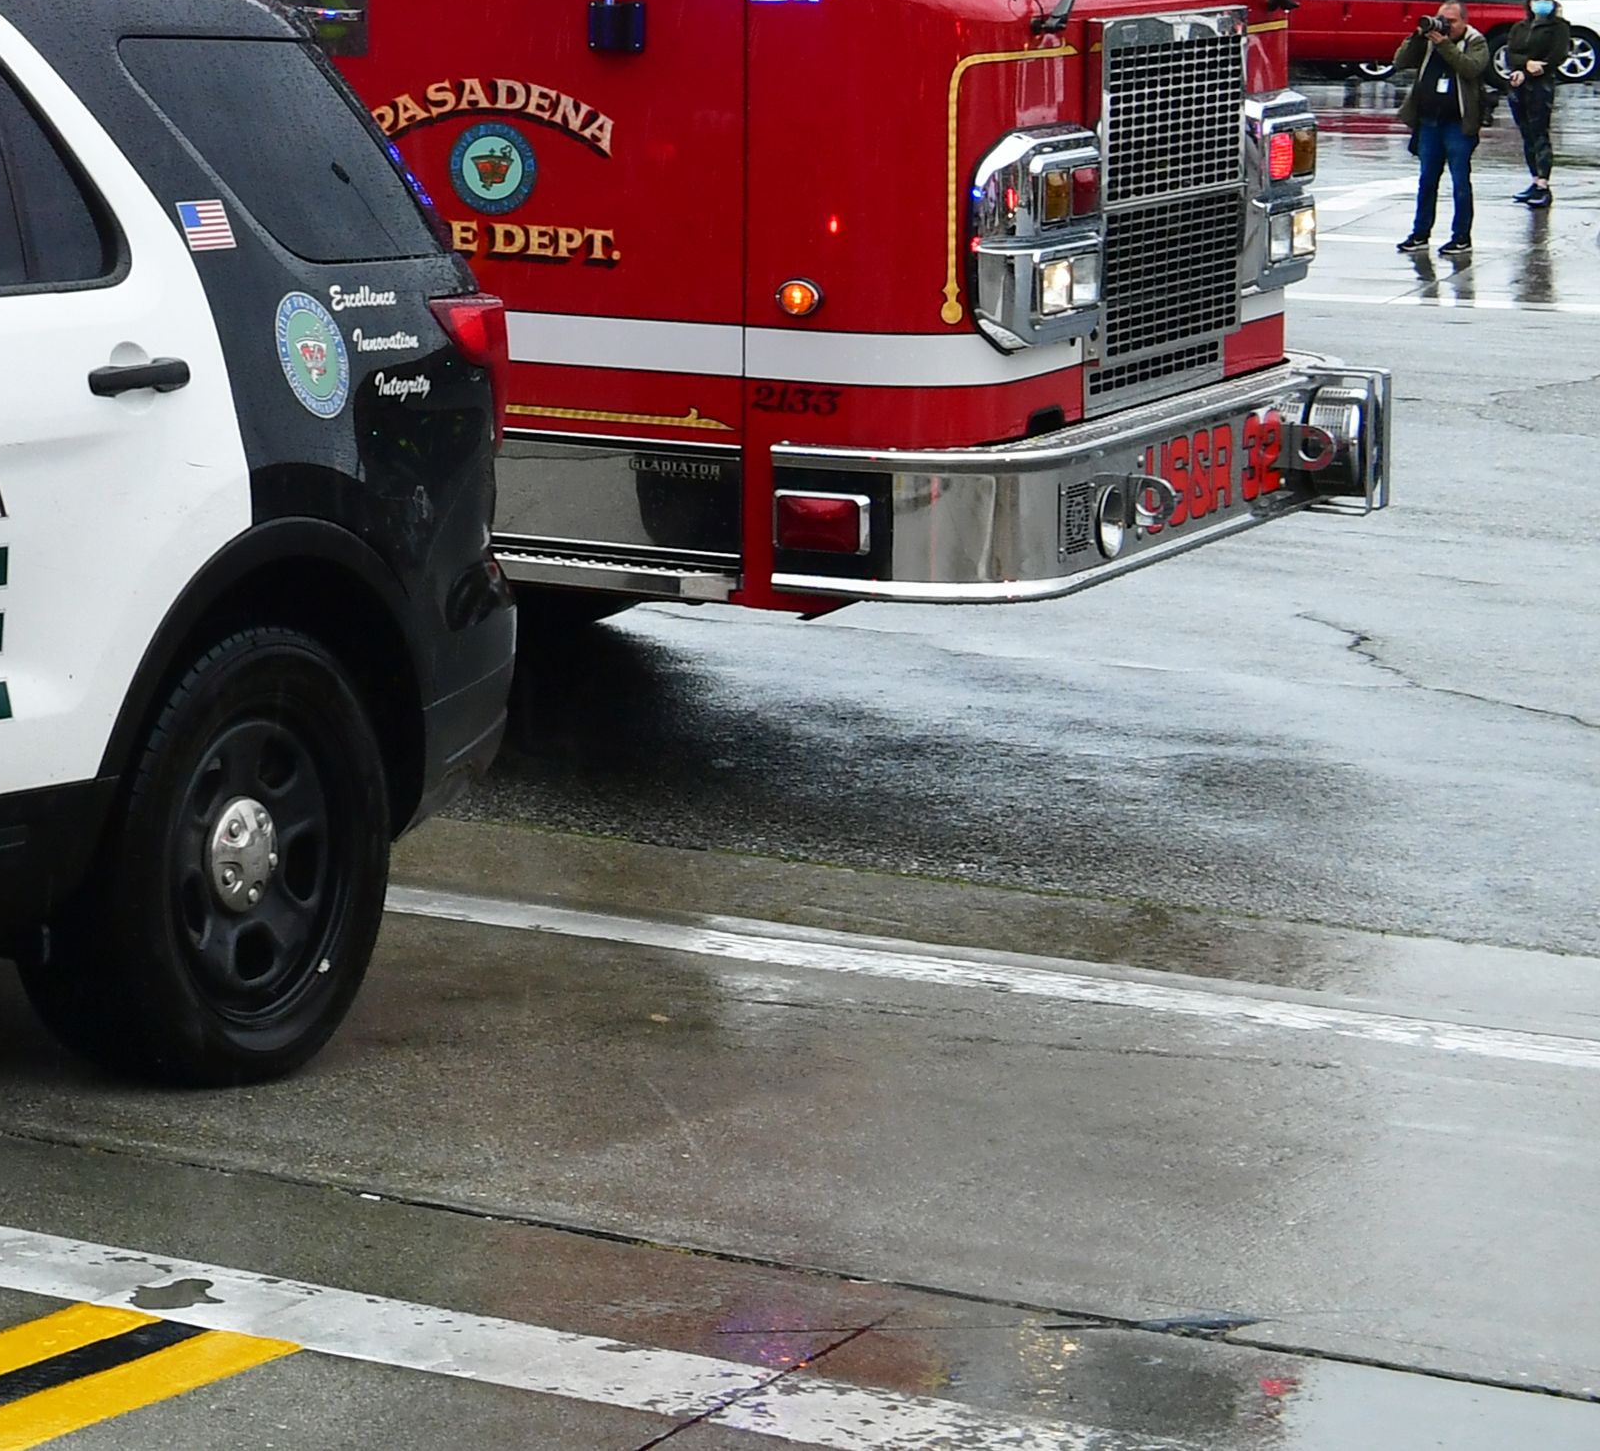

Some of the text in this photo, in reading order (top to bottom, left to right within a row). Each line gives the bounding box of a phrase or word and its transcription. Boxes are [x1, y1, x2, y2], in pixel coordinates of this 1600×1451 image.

[490, 223, 621, 261] DEPT.
[328, 284, 398, 312] Excellence
[352, 328, 419, 352] Innovation
[374, 372, 431, 402] Integrity
[751, 385, 843, 416] 2133
[630, 458, 720, 476] GLADIATOR
[1241, 408, 1282, 502] 32
